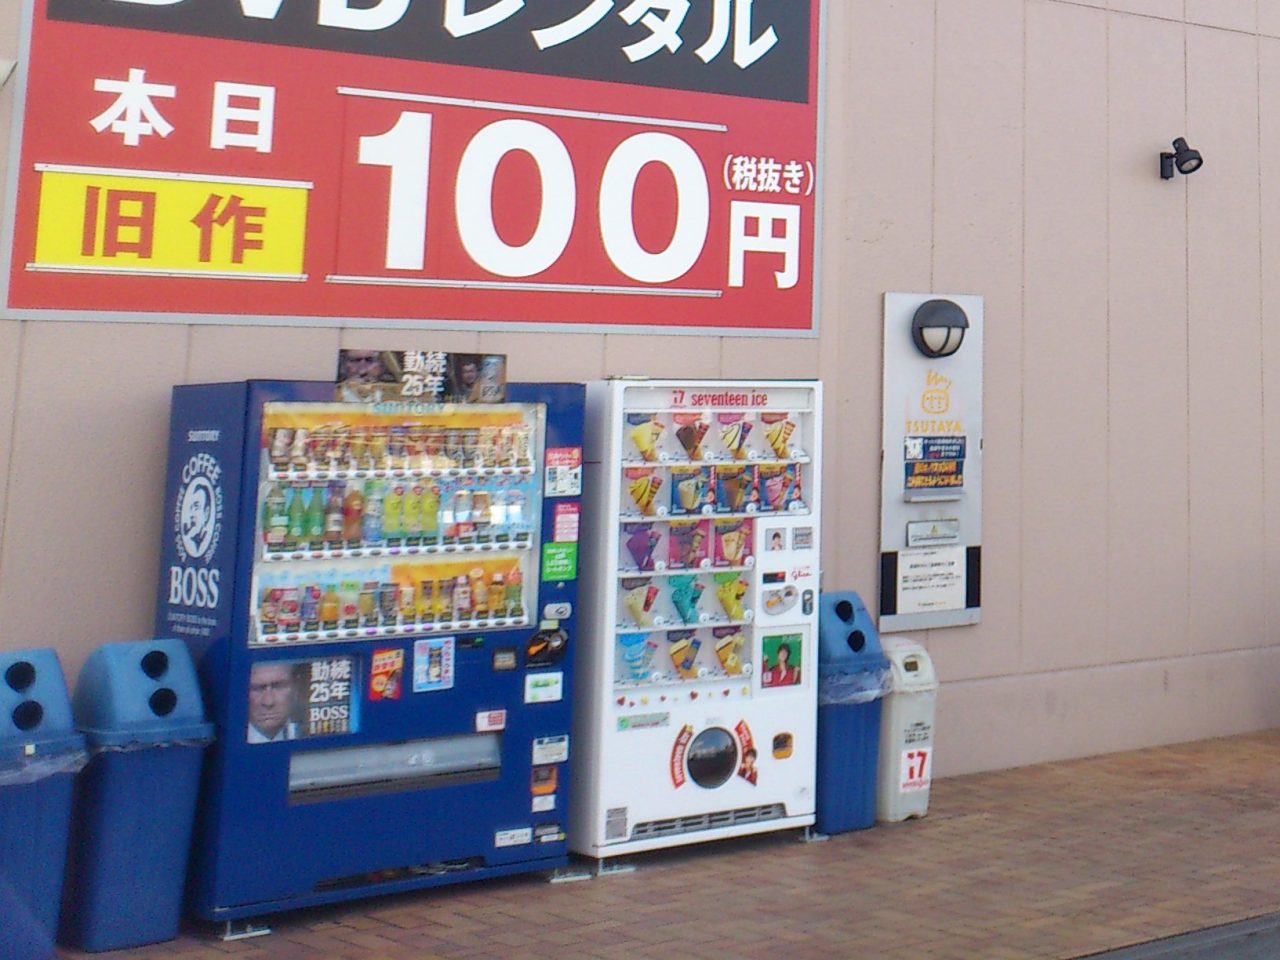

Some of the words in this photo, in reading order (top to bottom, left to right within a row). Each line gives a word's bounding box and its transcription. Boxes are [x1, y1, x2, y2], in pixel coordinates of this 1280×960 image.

[90, 68, 276, 153] 本日
[81, 185, 267, 264] 旧作
[401, 374, 445, 396] 25年
[691, 391, 748, 406] seventeen
[751, 389, 768, 406] ice
[905, 420, 962, 433] TSUTAYA
[168, 566, 220, 608] BOSS
[310, 660, 351, 682] 勤続
[309, 681, 350, 703] 25年
[310, 705, 348, 721] BOSS
